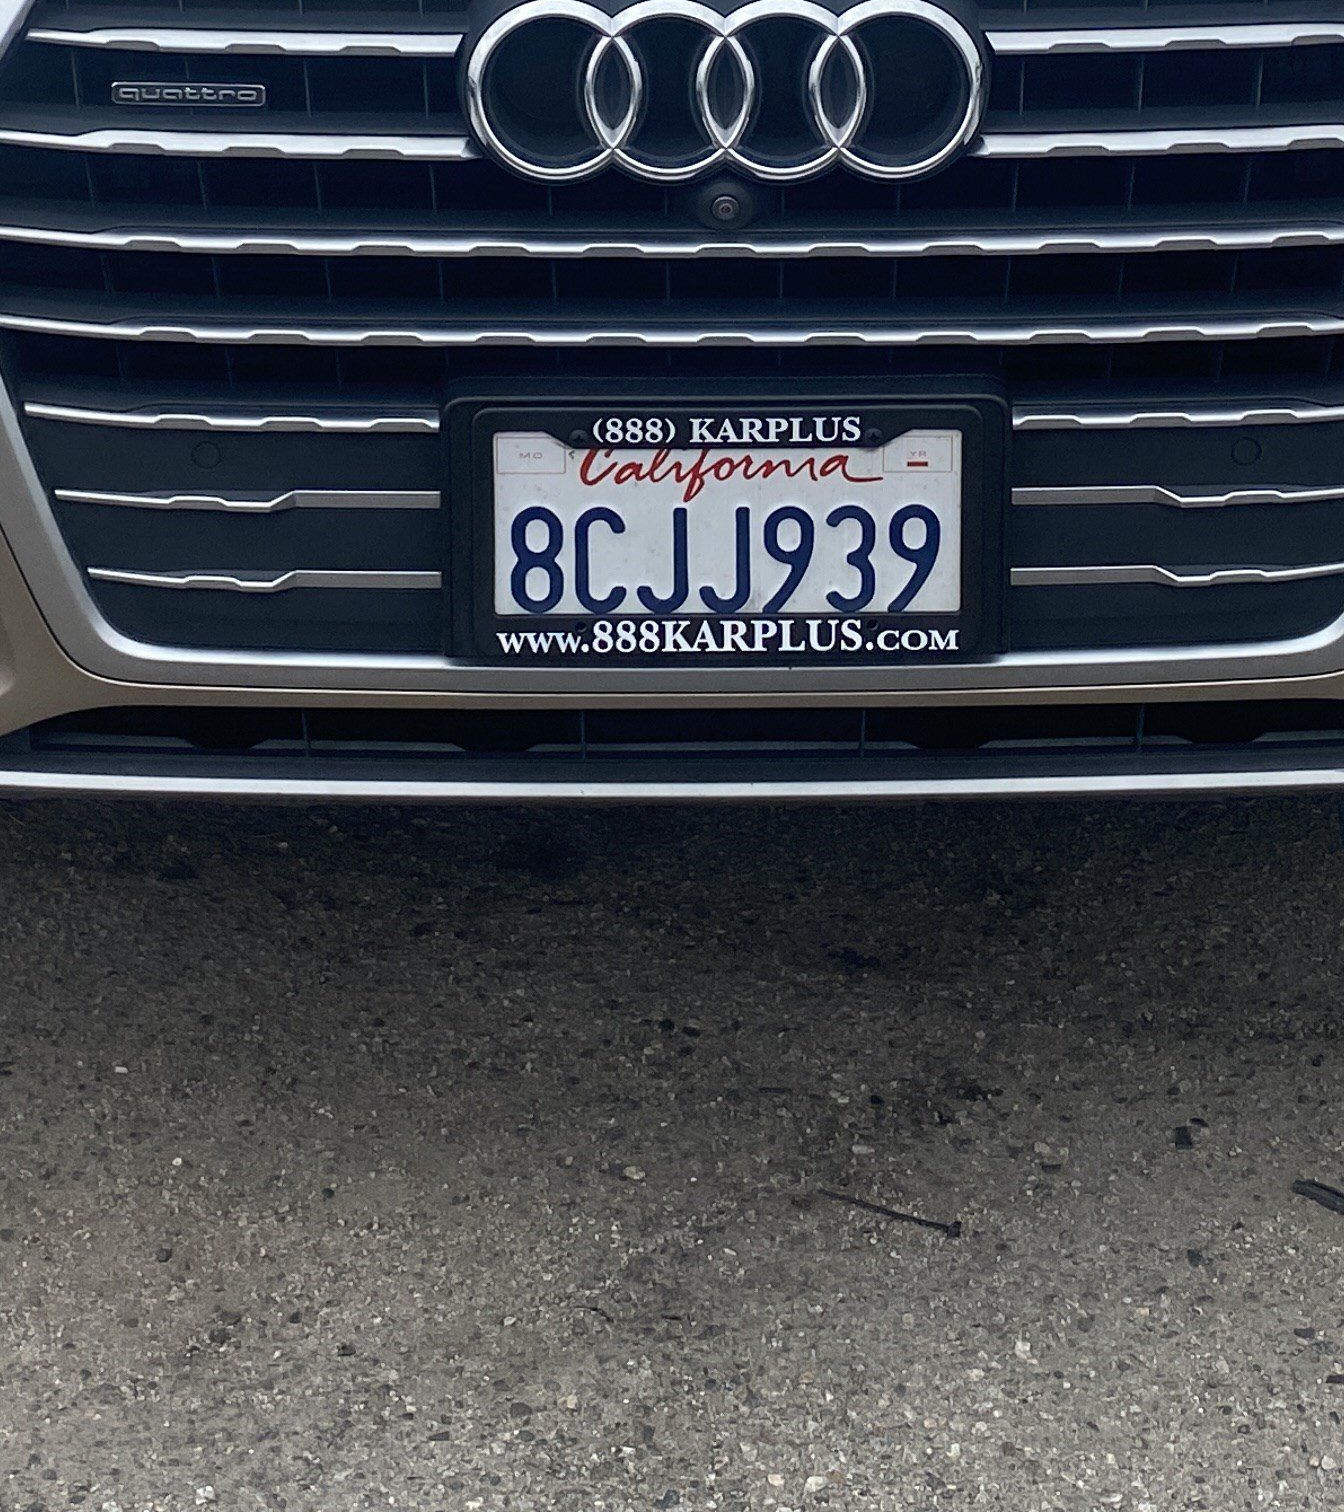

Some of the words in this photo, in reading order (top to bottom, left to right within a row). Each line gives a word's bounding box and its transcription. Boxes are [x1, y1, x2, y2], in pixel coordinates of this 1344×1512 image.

[118, 86, 258, 102] quattro
[592, 417, 677, 444] (888)
[688, 417, 862, 444] KARPLUS
[580, 448, 884, 503] California
[510, 504, 942, 614] 8CJJ939
